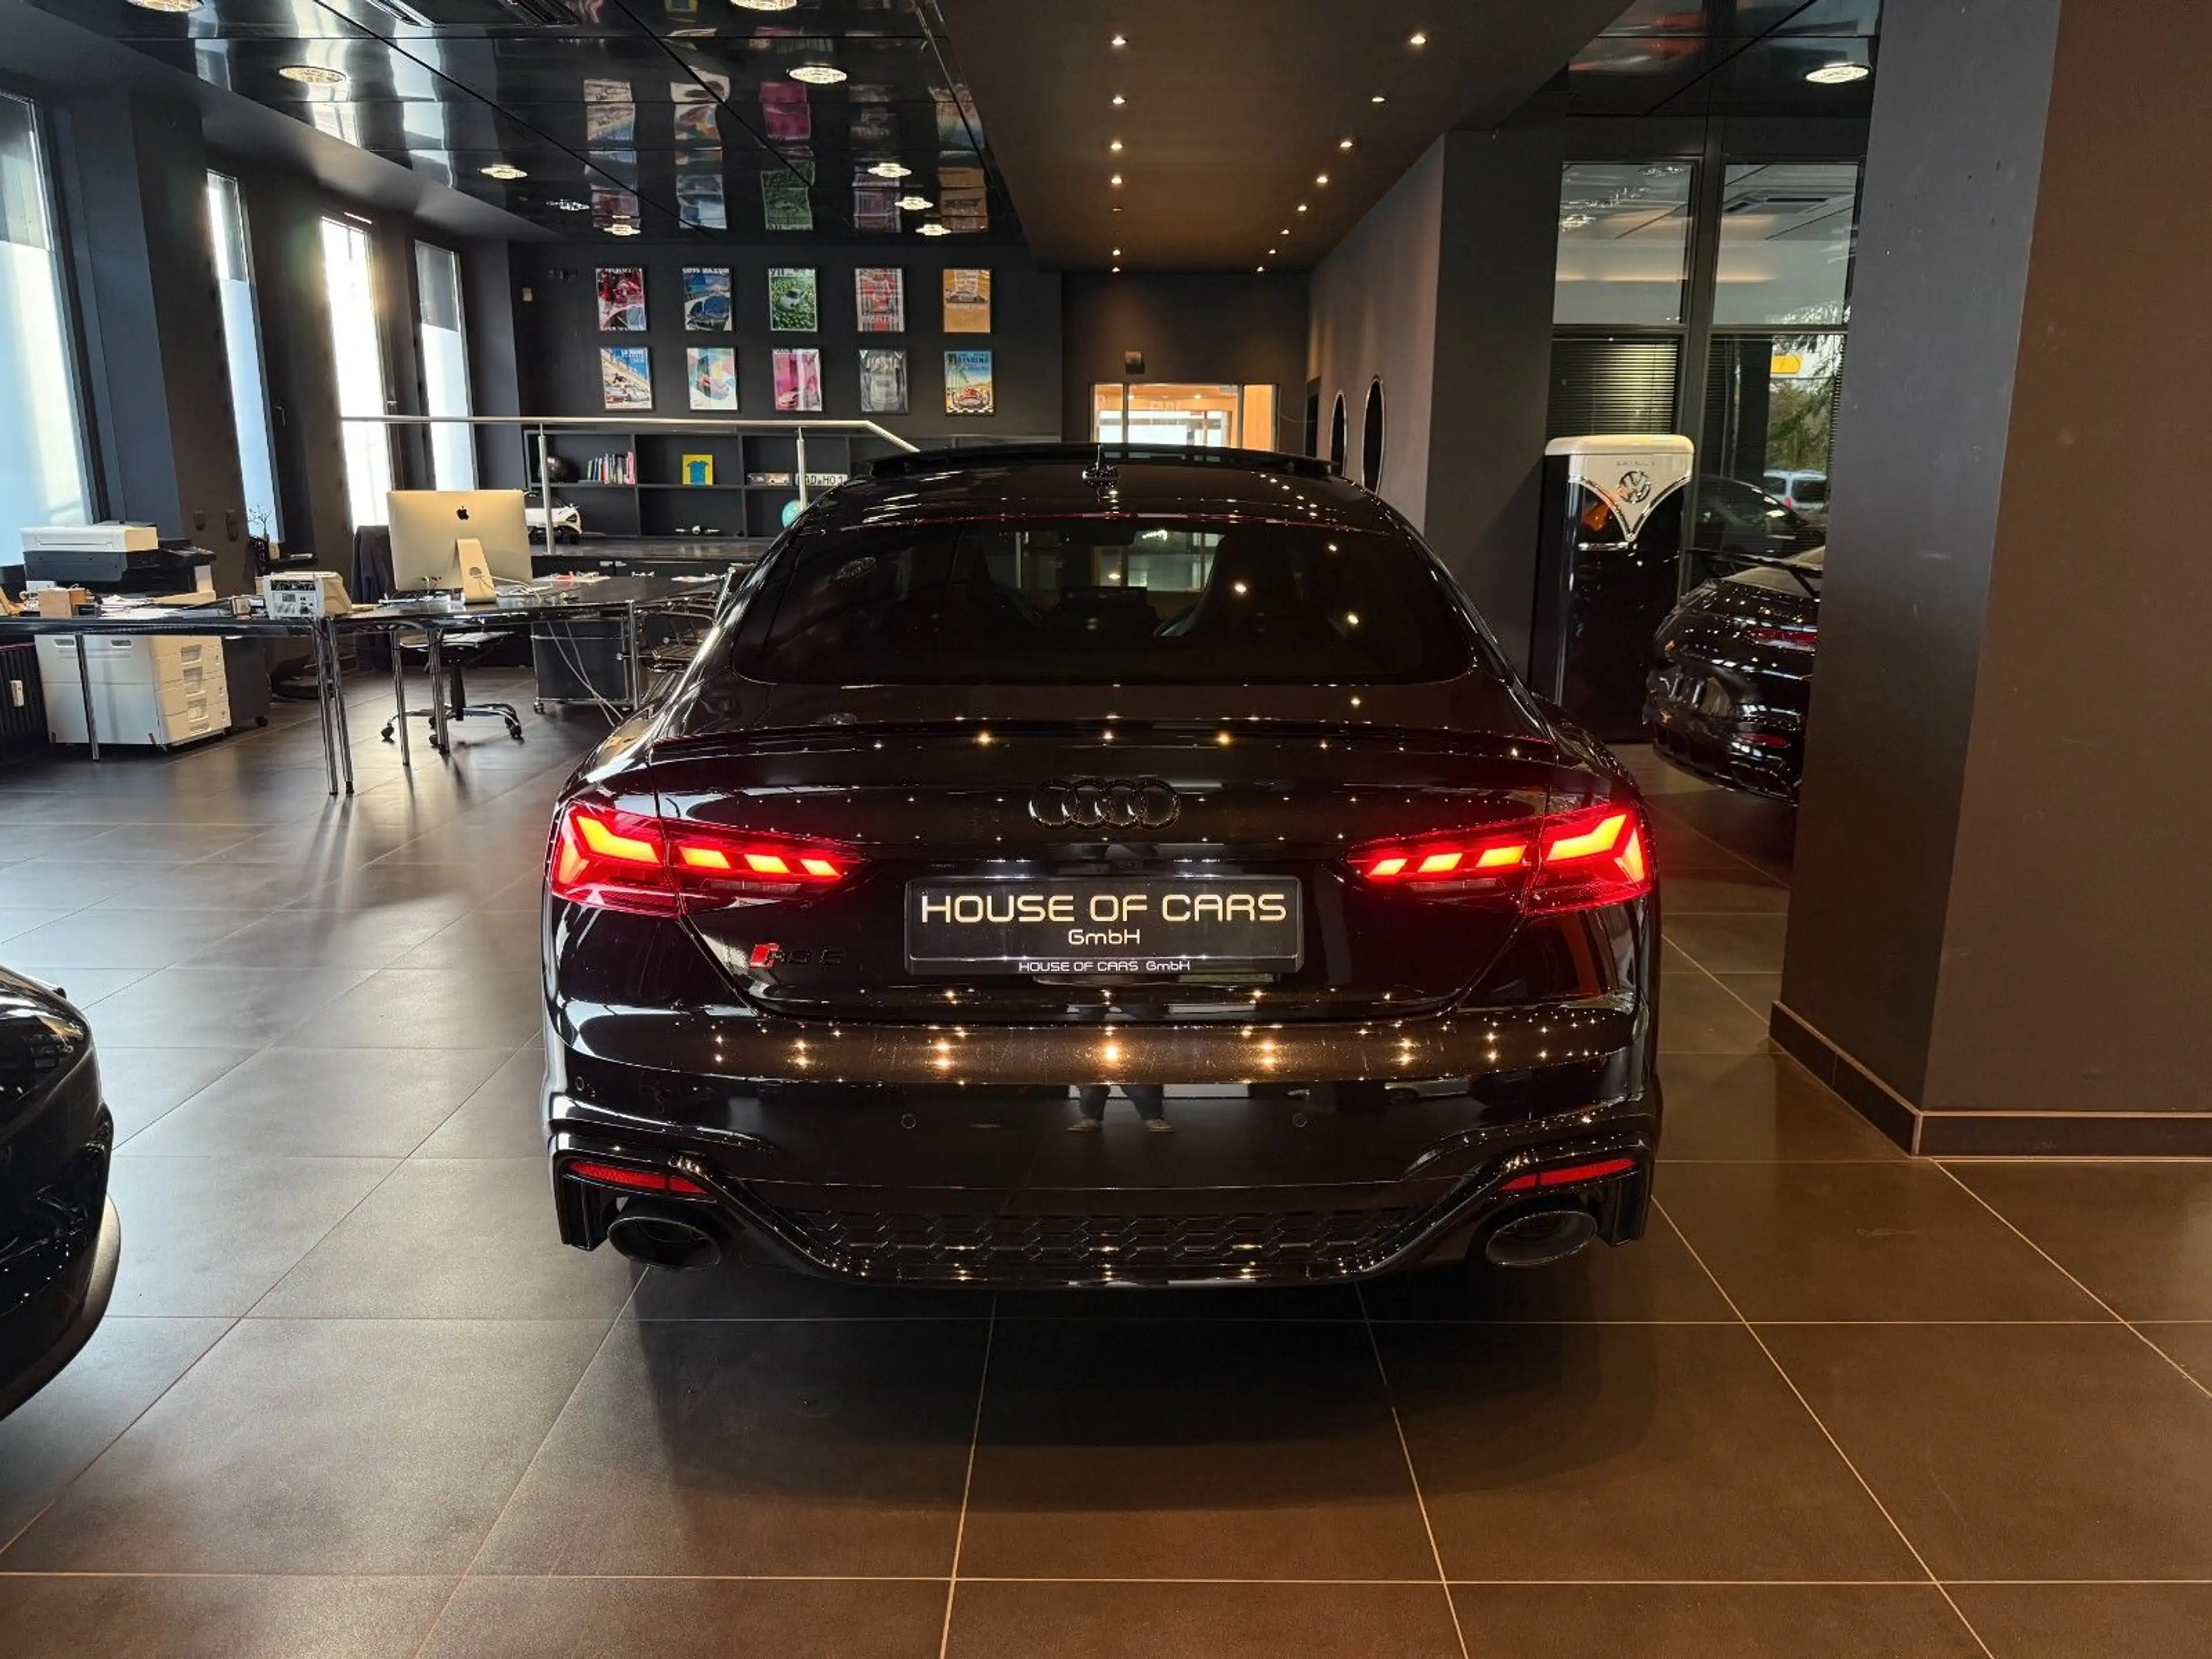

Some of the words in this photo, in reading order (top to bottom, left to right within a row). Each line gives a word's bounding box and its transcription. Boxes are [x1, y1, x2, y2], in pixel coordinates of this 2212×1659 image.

[922, 895, 1075, 923] HOUSE
[1089, 894, 1148, 922] OF
[1162, 893, 1287, 922] CARS
[1067, 929, 1141, 945] GmbH
[1019, 961, 1070, 972] HOUSE
[1074, 961, 1094, 972] OF
[1097, 961, 1139, 972] CARS
[1146, 961, 1190, 972] GmbH
